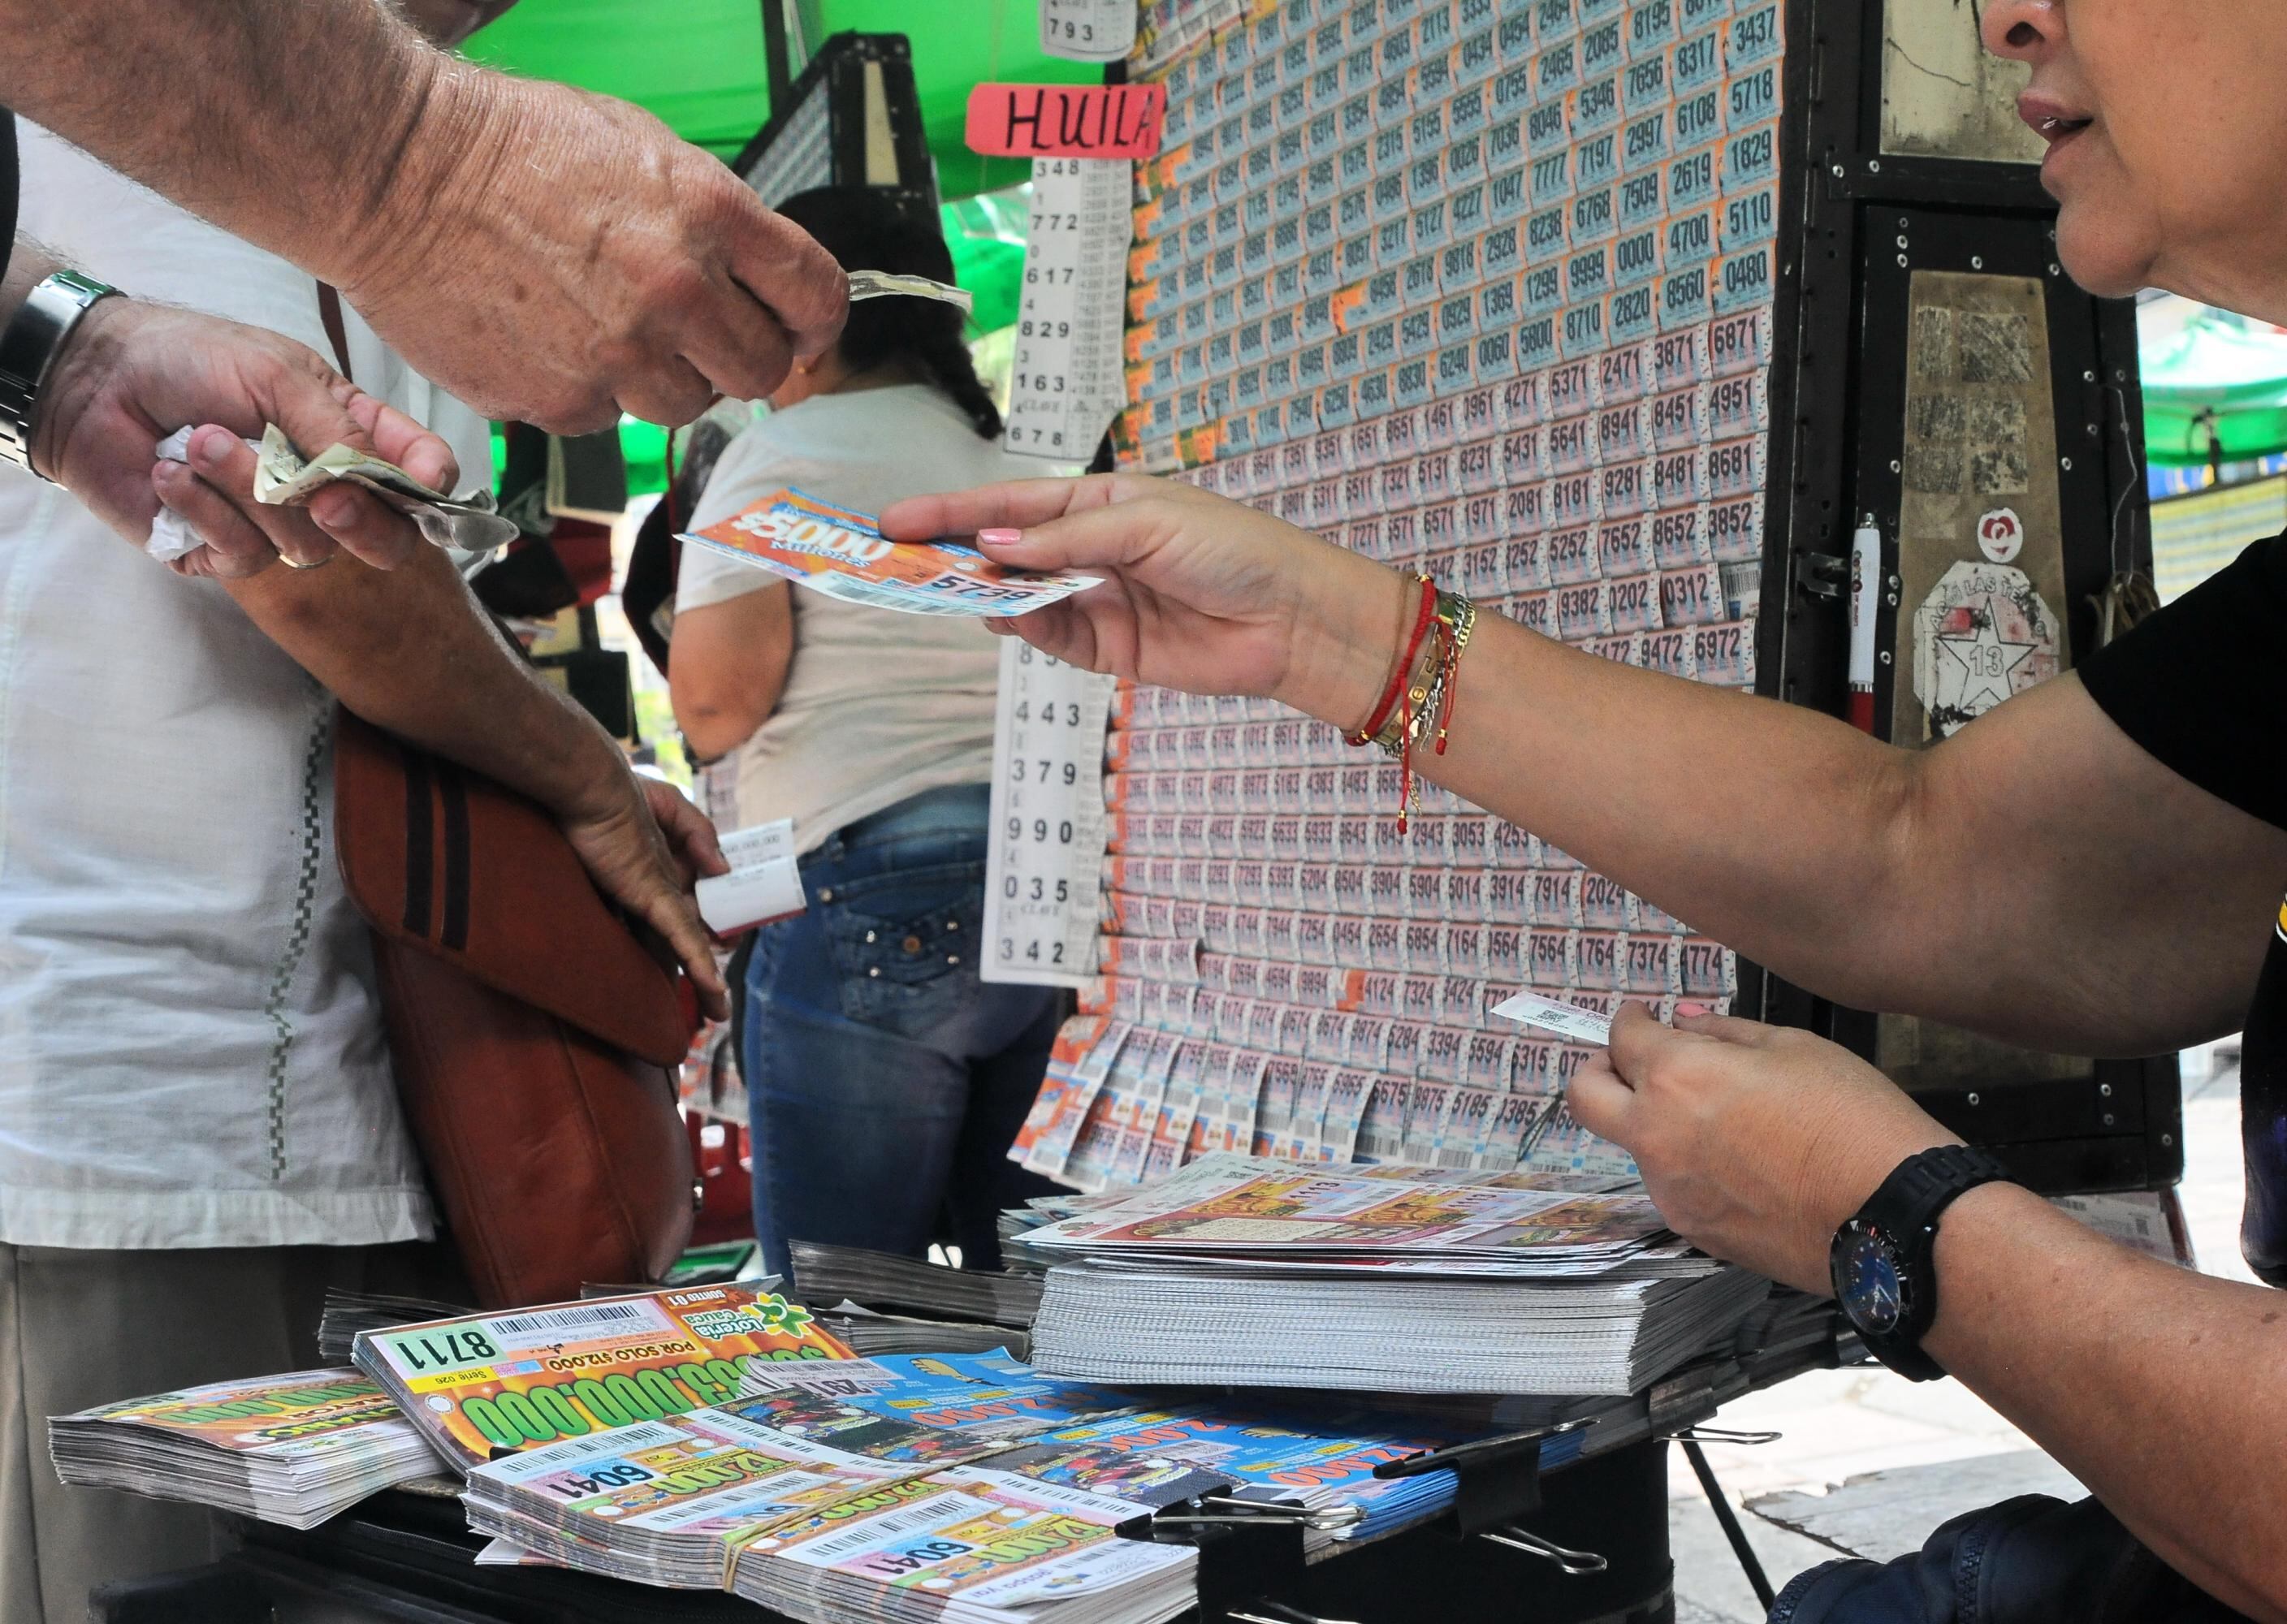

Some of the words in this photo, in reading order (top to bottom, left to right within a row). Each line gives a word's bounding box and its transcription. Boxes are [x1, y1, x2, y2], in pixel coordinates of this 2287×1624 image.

[1049, 18, 1093, 41] 793
[1634, 1, 1671, 39] 8195
[1736, 6, 1776, 51] 3437
[1585, 21, 1619, 63] 2085
[1678, 32, 1716, 76] 8317
[1628, 56, 1663, 97] 7656
[1732, 68, 1773, 113] 5718
[1580, 78, 1615, 119] 5346
[1678, 92, 1716, 135] 6108
[1005, 86, 1153, 149] HUILA
[1530, 102, 1561, 140] 8046
[1628, 113, 1663, 158] 2997
[1732, 129, 1771, 173] 1829
[1580, 135, 1614, 175] 7197
[1534, 153, 1566, 192] 7777
[1673, 153, 1711, 195] 2619
[1576, 189, 1610, 228] 6768
[1623, 172, 1658, 214] 7509
[1032, 214, 1079, 231] 772
[1529, 208, 1562, 246] 8238
[1730, 192, 1770, 234] 5110
[1671, 214, 1709, 253] 4700
[1618, 232, 1654, 271] 0000
[1027, 267, 1074, 284] 617
[1570, 249, 1605, 287] 9999
[1726, 250, 1767, 292] 0480
[1527, 266, 1558, 304] 1299
[1667, 268, 1705, 309] 8560
[1567, 304, 1600, 340] 8710
[1615, 287, 1650, 327] 2820
[1021, 321, 1070, 338] 829
[1520, 318, 1553, 353] 5800
[1714, 315, 1757, 353] 6871
[1603, 348, 1641, 384] 2471
[1654, 332, 1694, 369] 3871
[1017, 374, 1065, 392] 163
[1504, 377, 1537, 408] 4271
[1552, 364, 1587, 396] 5371
[1710, 378, 1752, 414] 4951
[1601, 406, 1638, 440] 8941
[1654, 392, 1694, 427] 8451
[1011, 427, 1062, 446] 678
[1504, 432, 1537, 463] 5431
[1550, 420, 1585, 452] 5641
[1654, 454, 1694, 486] 8481
[1709, 443, 1752, 479] 8681
[1554, 477, 1589, 508] 8181
[1604, 465, 1642, 496] 9281
[1509, 488, 1541, 518] 2081
[1653, 512, 1696, 546] 8652
[1708, 502, 1753, 538] 3852
[1550, 531, 1587, 561] 5252
[1602, 522, 1641, 555] 7652
[932, 576, 1035, 600] 5739
[1562, 587, 1598, 617] 9382
[1610, 581, 1648, 611] 0202
[1665, 572, 1709, 606] 0312
[1964, 577, 1996, 596] LAS
[1513, 598, 1546, 624] 7282
[1641, 634, 1683, 664] 9472
[1695, 628, 1740, 660] 6972
[1969, 645, 2004, 677] 13
[1016, 701, 1080, 727] 443
[1013, 759, 1076, 785] 379
[1008, 818, 1072, 844] 990
[1453, 822, 1485, 847] 3053
[1005, 876, 1068, 902] 035
[1490, 875, 1524, 903] 3914
[1536, 876, 1571, 904] 7914
[1001, 939, 1064, 963] 342
[1530, 935, 1566, 962] 7564
[1576, 939, 1615, 967] 1764
[1628, 941, 1668, 971] 7374
[1680, 944, 1723, 975] 4774
[1511, 1043, 1550, 1072] 6315
[1290, 1181, 1340, 1199] 1113
[668, 1296, 687, 1307] 01
[686, 1289, 726, 1302] SORTEO
[685, 1310, 737, 1323] Cauca
[396, 1331, 496, 1370] 8711
[549, 1352, 615, 1371] $12.000
[616, 1345, 659, 1361] SOLO
[659, 1341, 696, 1354] POR
[435, 1376, 456, 1384] 026
[458, 1371, 487, 1380] Serie
[791, 1379, 871, 1397] 291
[547, 1465, 654, 1498] 6041
[865, 1543, 974, 1574] 6041
